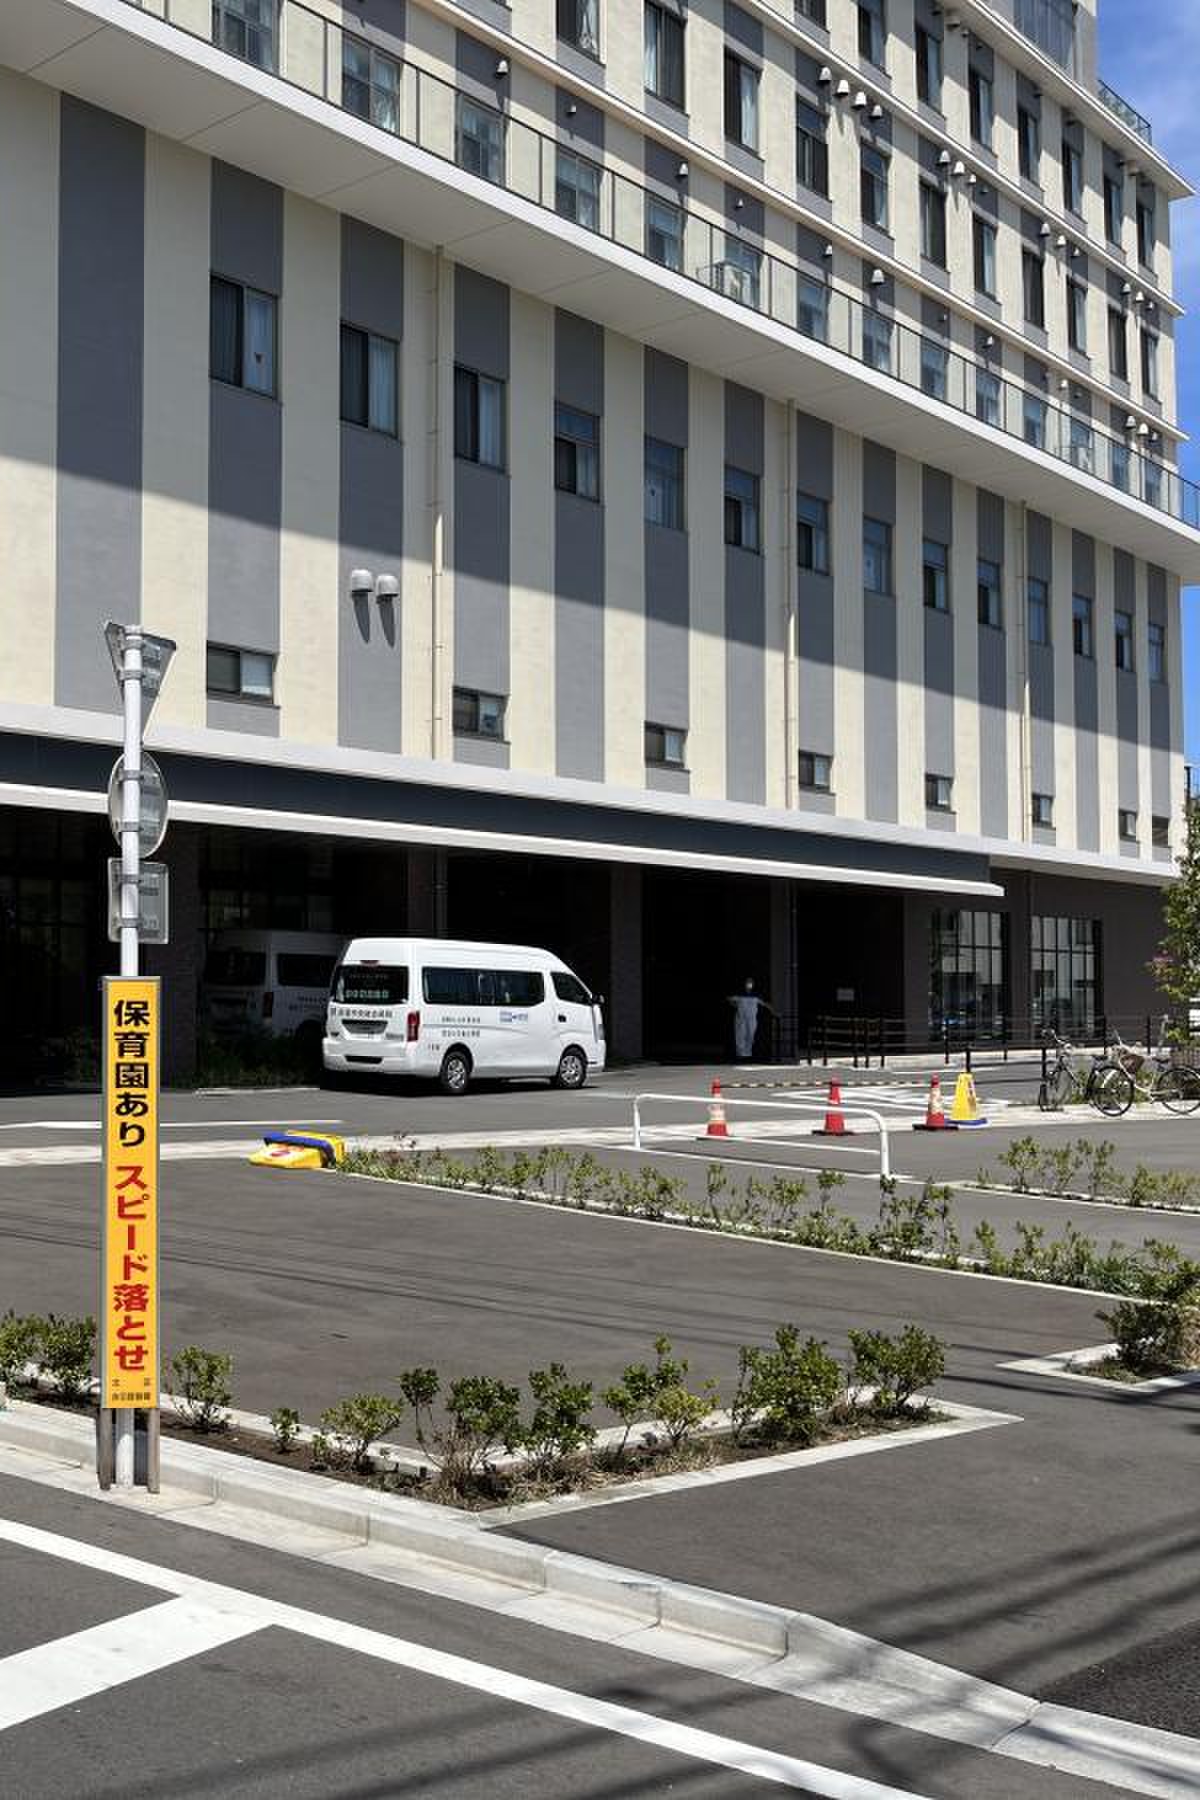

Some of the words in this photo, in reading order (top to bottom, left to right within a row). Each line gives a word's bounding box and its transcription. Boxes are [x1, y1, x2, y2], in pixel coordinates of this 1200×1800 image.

[114, 999, 150, 1148] 保育園あり
[113, 1165, 150, 1371] スピード落とせ
